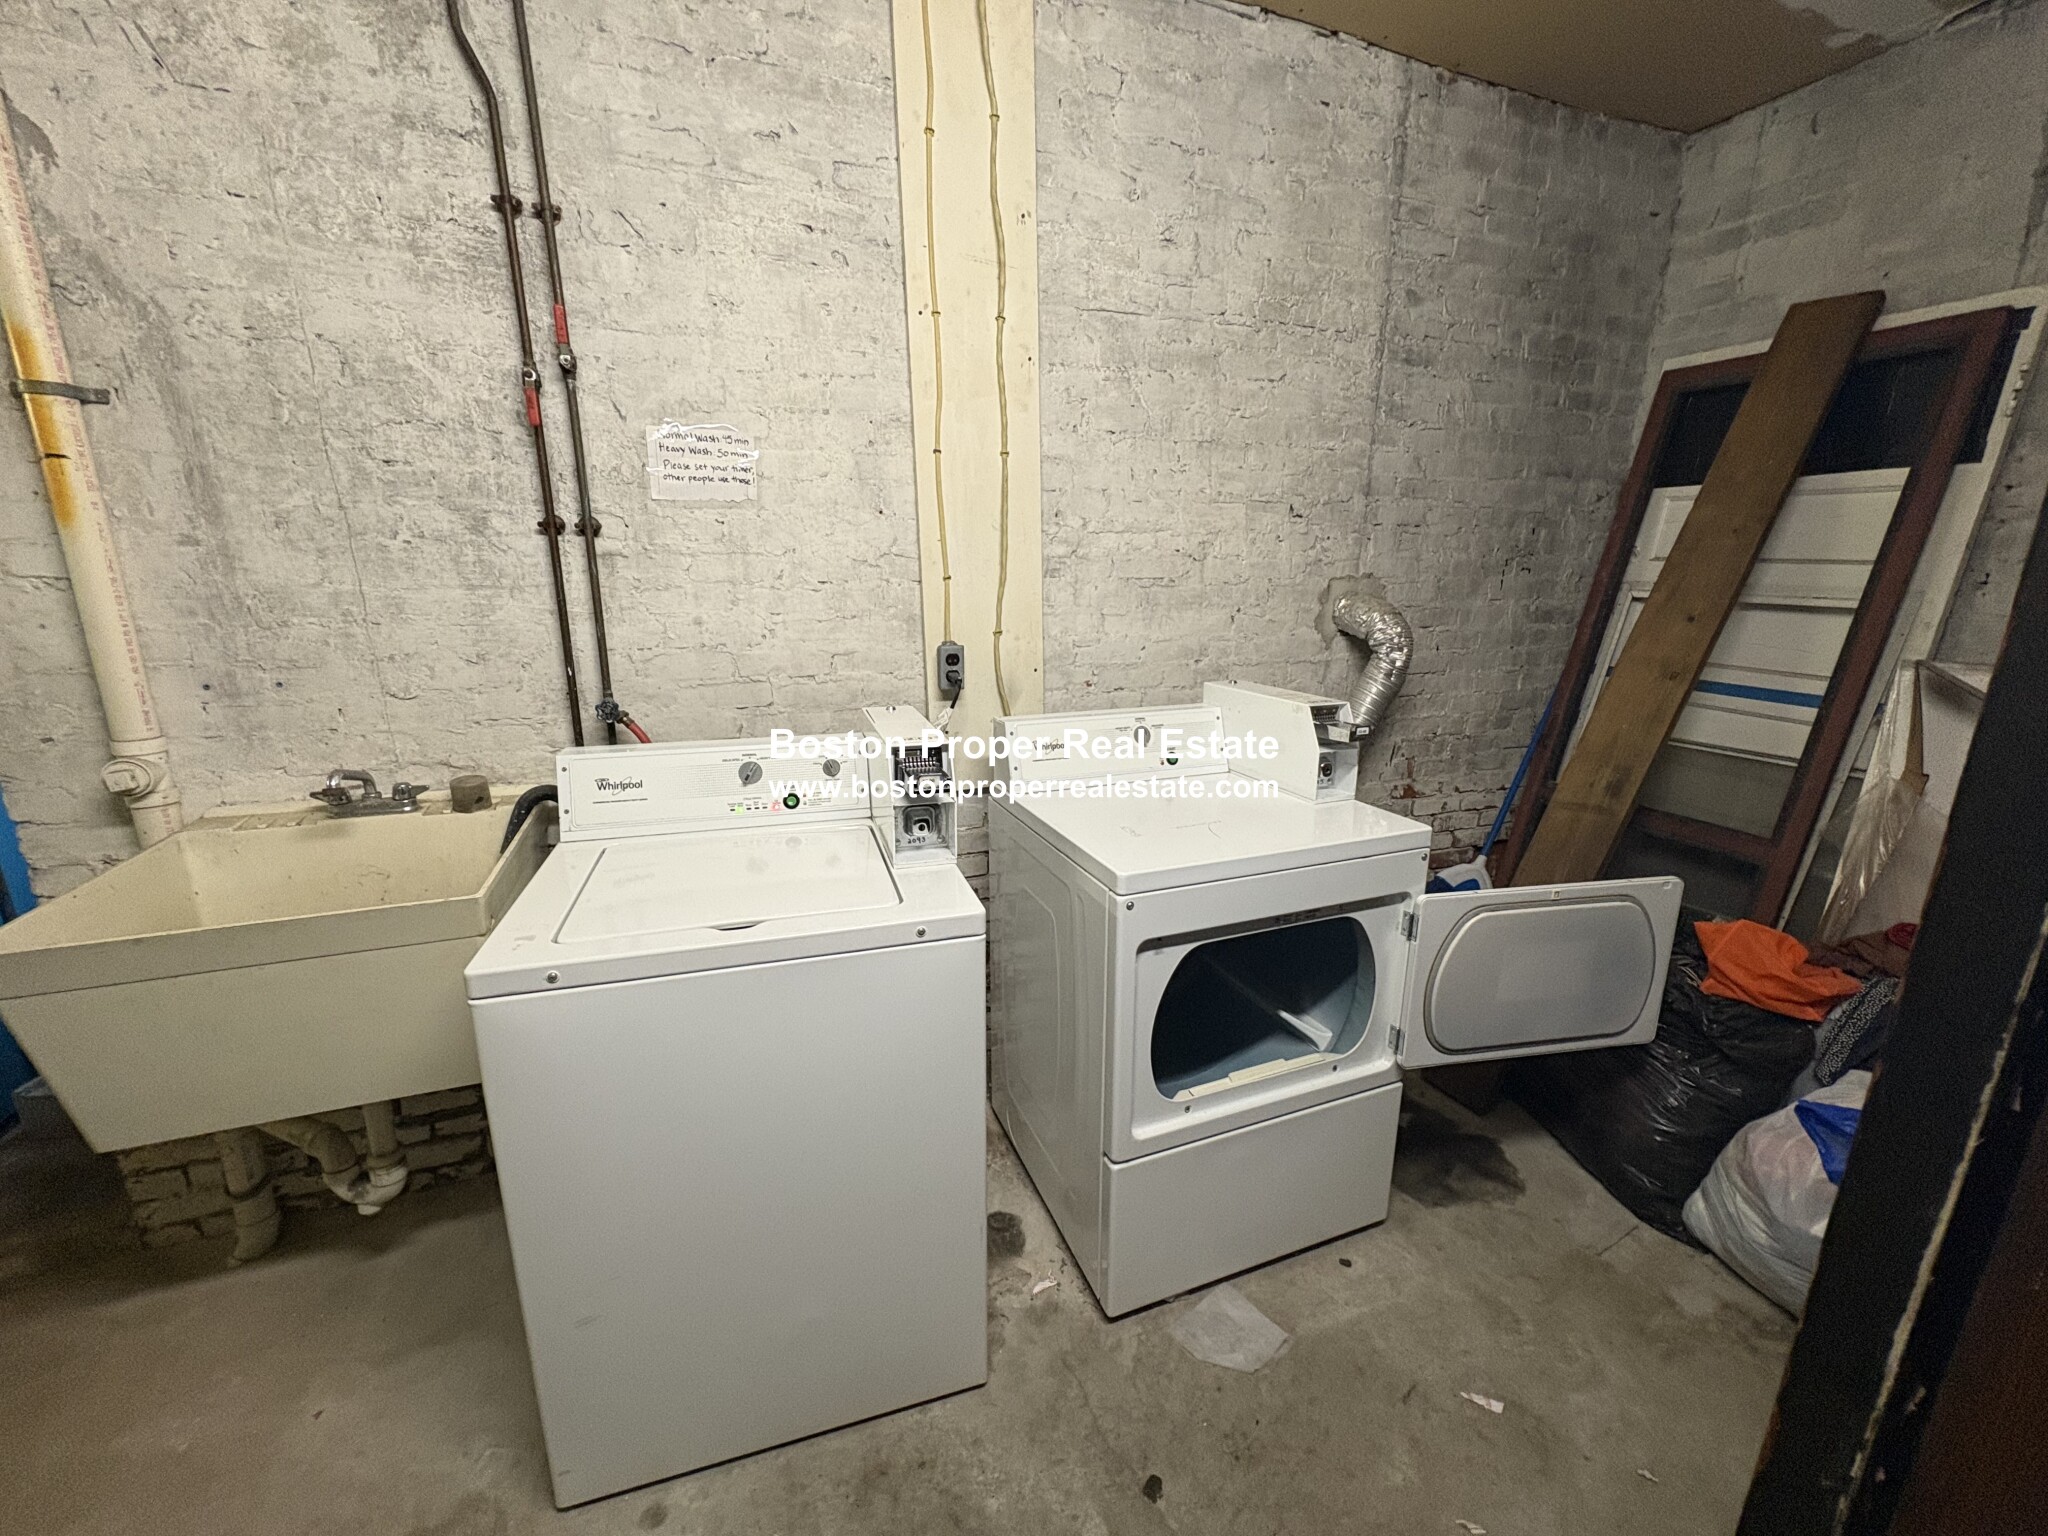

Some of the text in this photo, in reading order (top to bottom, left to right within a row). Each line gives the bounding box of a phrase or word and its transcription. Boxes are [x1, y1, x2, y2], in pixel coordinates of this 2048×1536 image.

[658, 442, 686, 457] Heavy
[663, 459, 691, 470] Please
[694, 463, 708, 471] set
[710, 465, 729, 474] your
[663, 473, 685, 482] other
[688, 475, 715, 485] people
[595, 778, 643, 792] Whirlpool
